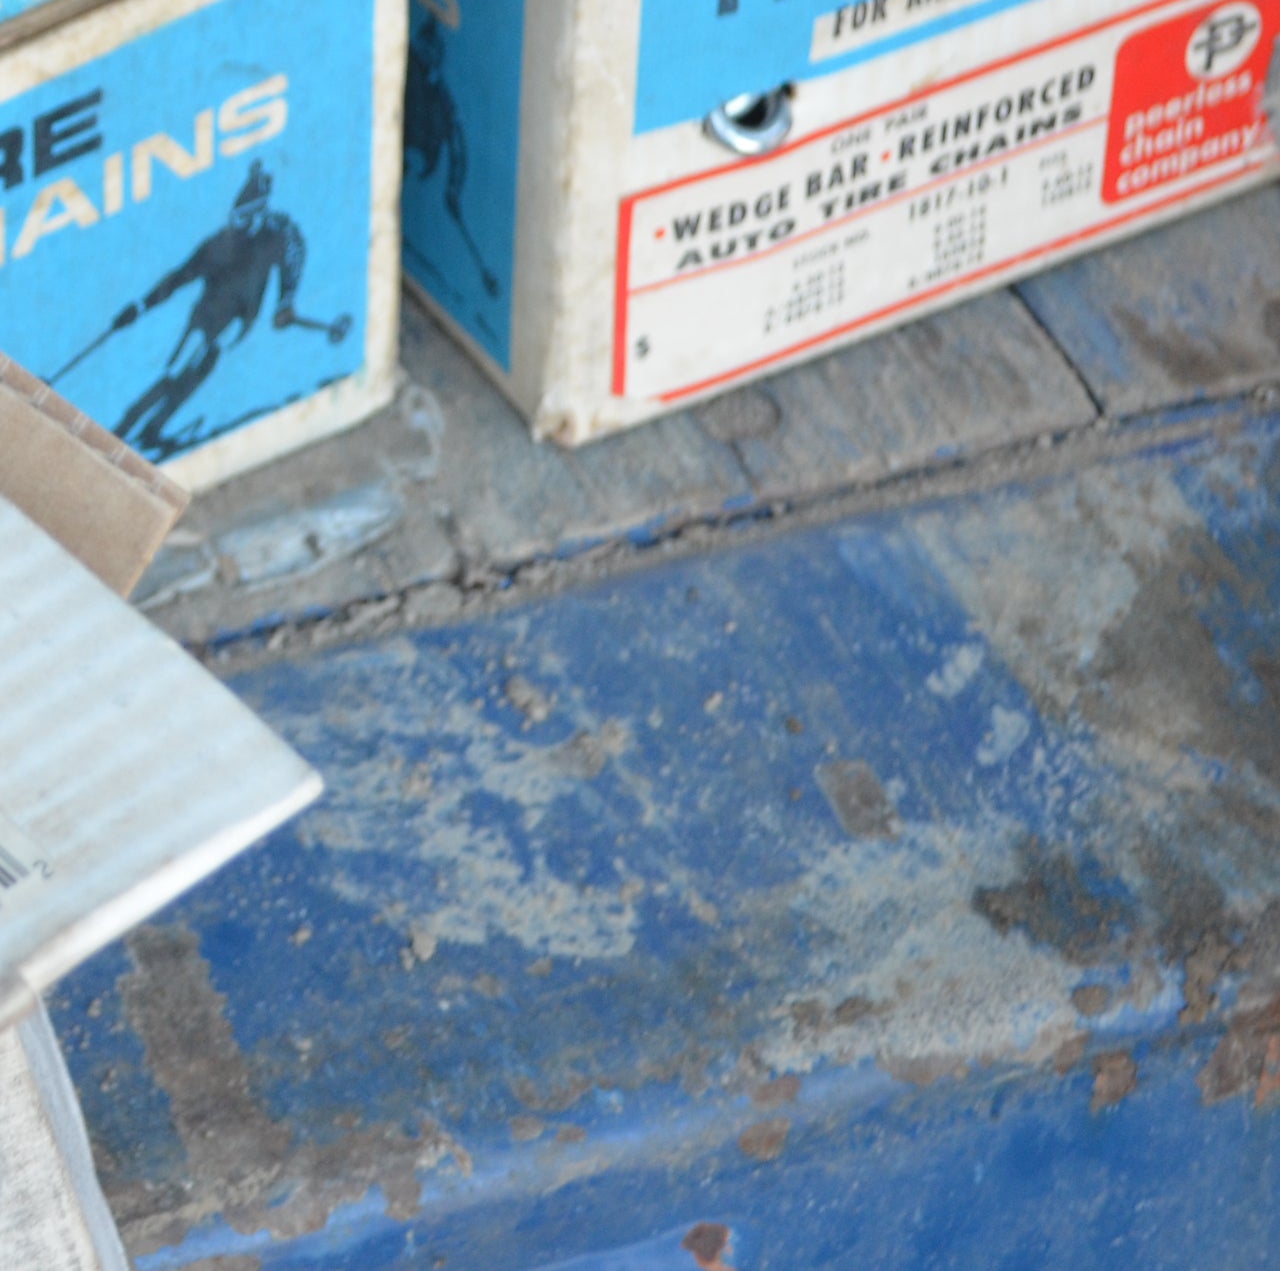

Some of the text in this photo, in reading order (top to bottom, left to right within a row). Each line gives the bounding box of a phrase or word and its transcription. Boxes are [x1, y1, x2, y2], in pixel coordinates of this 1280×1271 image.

[1119, 115, 1205, 166] chain
[1124, 71, 1253, 143] peerless
[672, 64, 1098, 243] WEDGE BAR REINFORCED
[675, 218, 796, 270] AUTO
[821, 169, 909, 220] TIRE
[927, 100, 1085, 176] CHAINS
[1116, 119, 1262, 195] company
